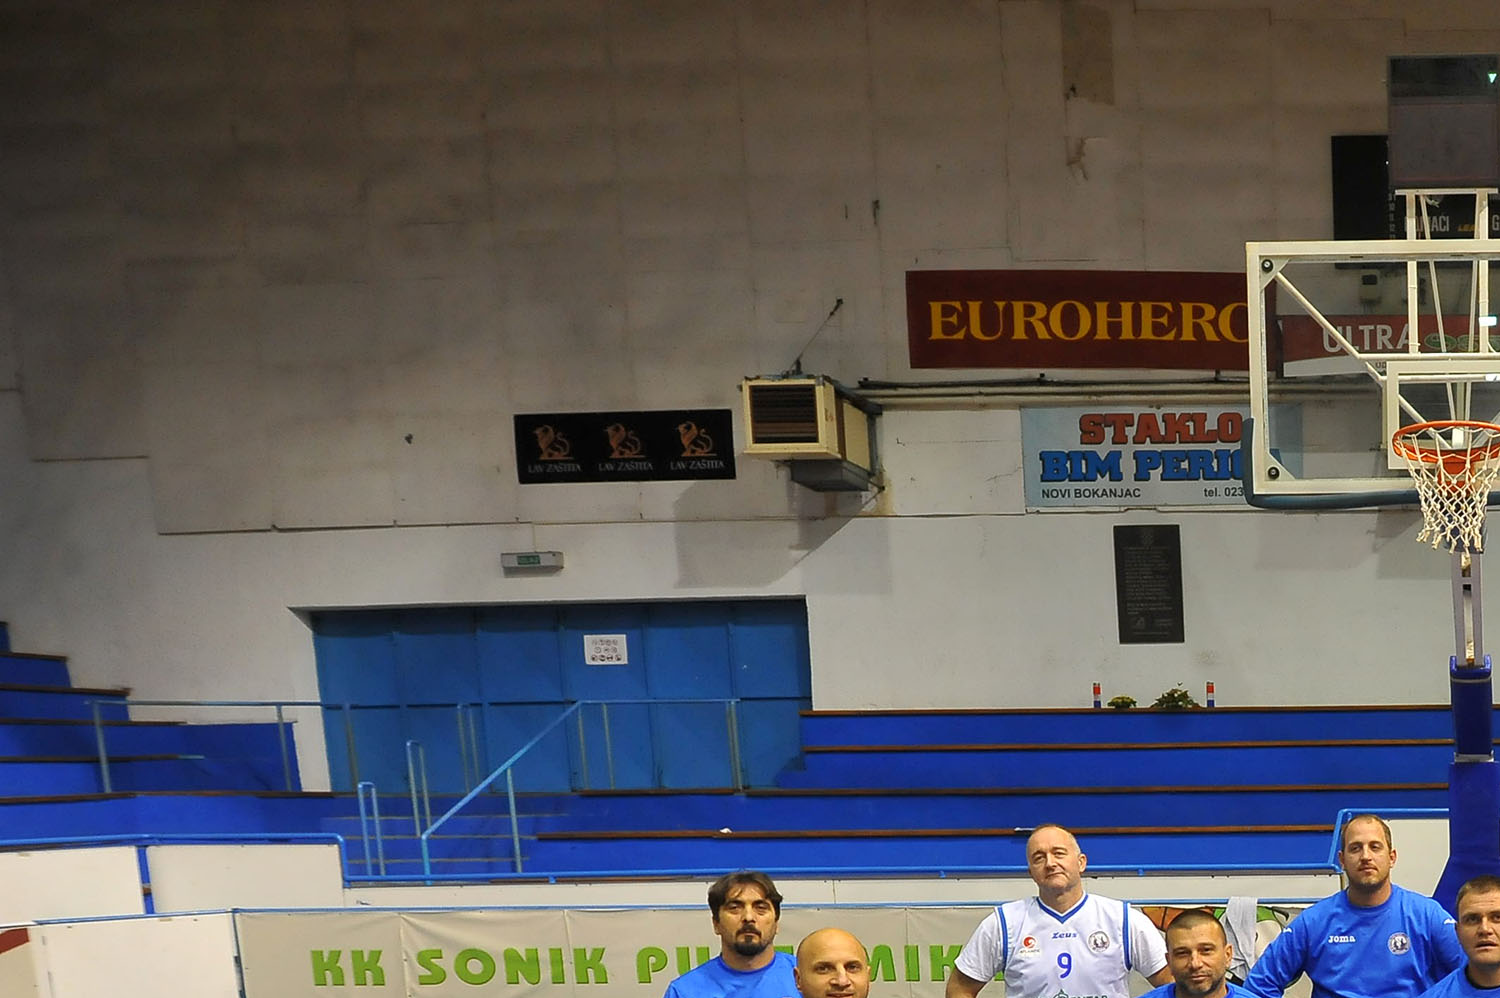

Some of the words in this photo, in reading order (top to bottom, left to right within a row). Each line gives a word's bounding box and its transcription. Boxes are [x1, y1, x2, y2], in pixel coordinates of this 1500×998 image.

[1079, 412, 1243, 445] STAKLO
[527, 464, 546, 474] LAV
[598, 462, 616, 472] LAV
[670, 460, 687, 470] LAV
[689, 458, 725, 470] ZAŠTITA
[1039, 450, 1124, 482] BIM
[1041, 488, 1071, 499] NOVI
[1074, 487, 1142, 499] BOKANJAC
[1203, 487, 1222, 498] tel.
[1224, 486, 1244, 498] 023
[1052, 931, 1078, 940] Zeus
[311, 948, 387, 987] KK
[417, 946, 608, 987] SONIK
[1057, 952, 1073, 979] 9
